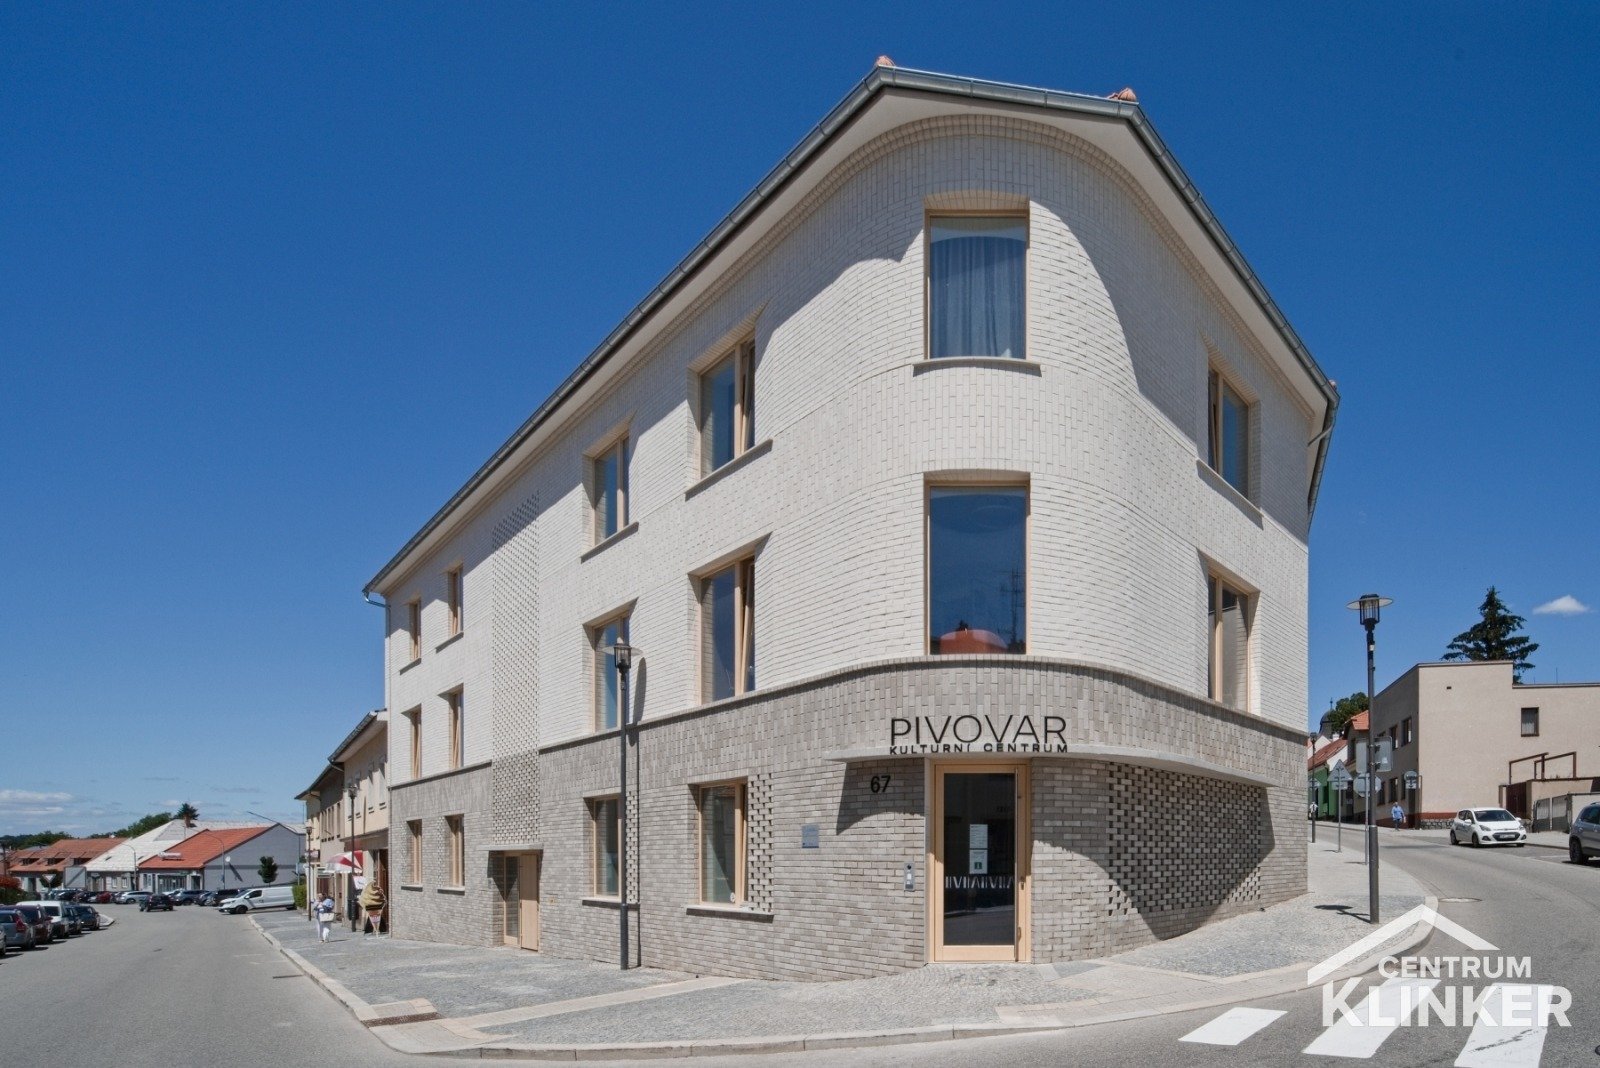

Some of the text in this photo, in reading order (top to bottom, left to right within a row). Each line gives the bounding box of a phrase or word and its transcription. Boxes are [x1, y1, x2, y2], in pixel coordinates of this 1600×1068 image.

[891, 715, 1067, 746] PIVOVAR
[984, 743, 1068, 753] CENTRUM
[870, 775, 891, 793] 67
